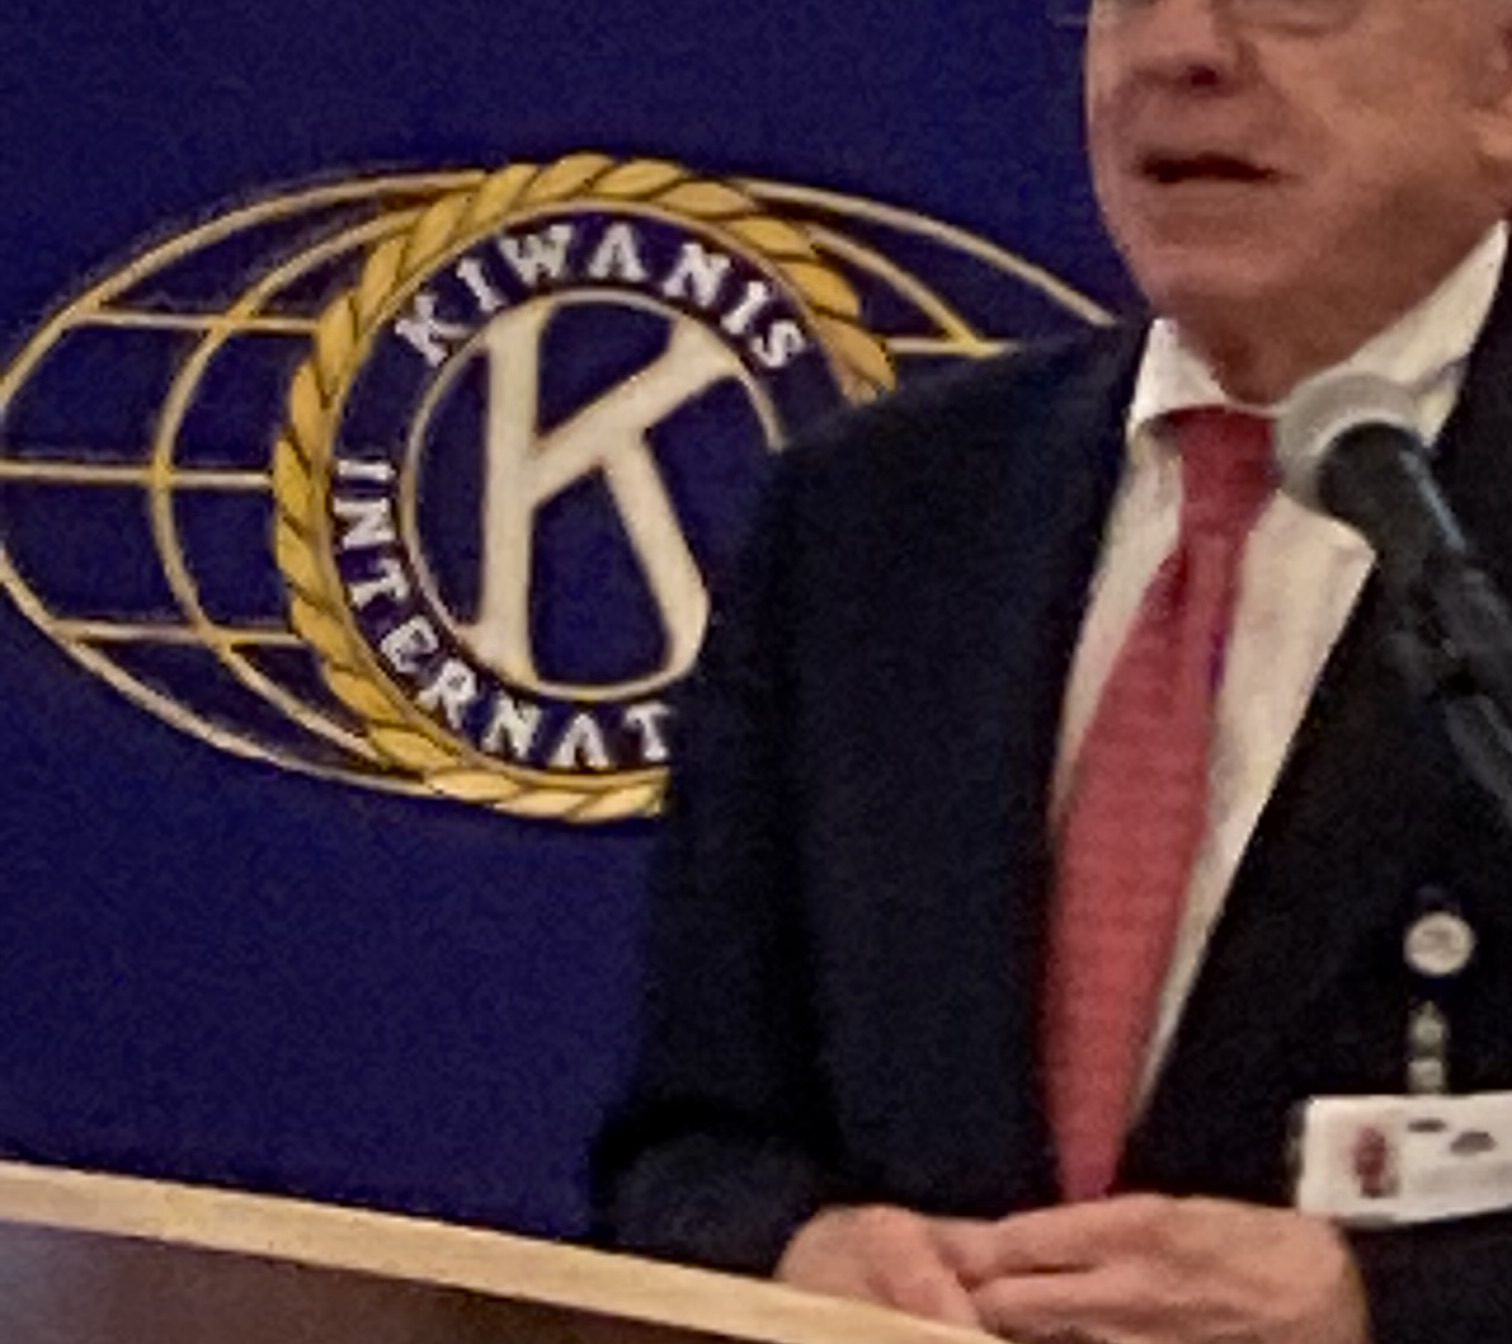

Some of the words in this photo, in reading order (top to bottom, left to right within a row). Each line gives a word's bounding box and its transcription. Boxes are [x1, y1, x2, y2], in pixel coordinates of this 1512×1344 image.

[395, 222, 805, 368] KIWANIS
[332, 456, 672, 770] INTERNAT
[472, 294, 738, 692] K
